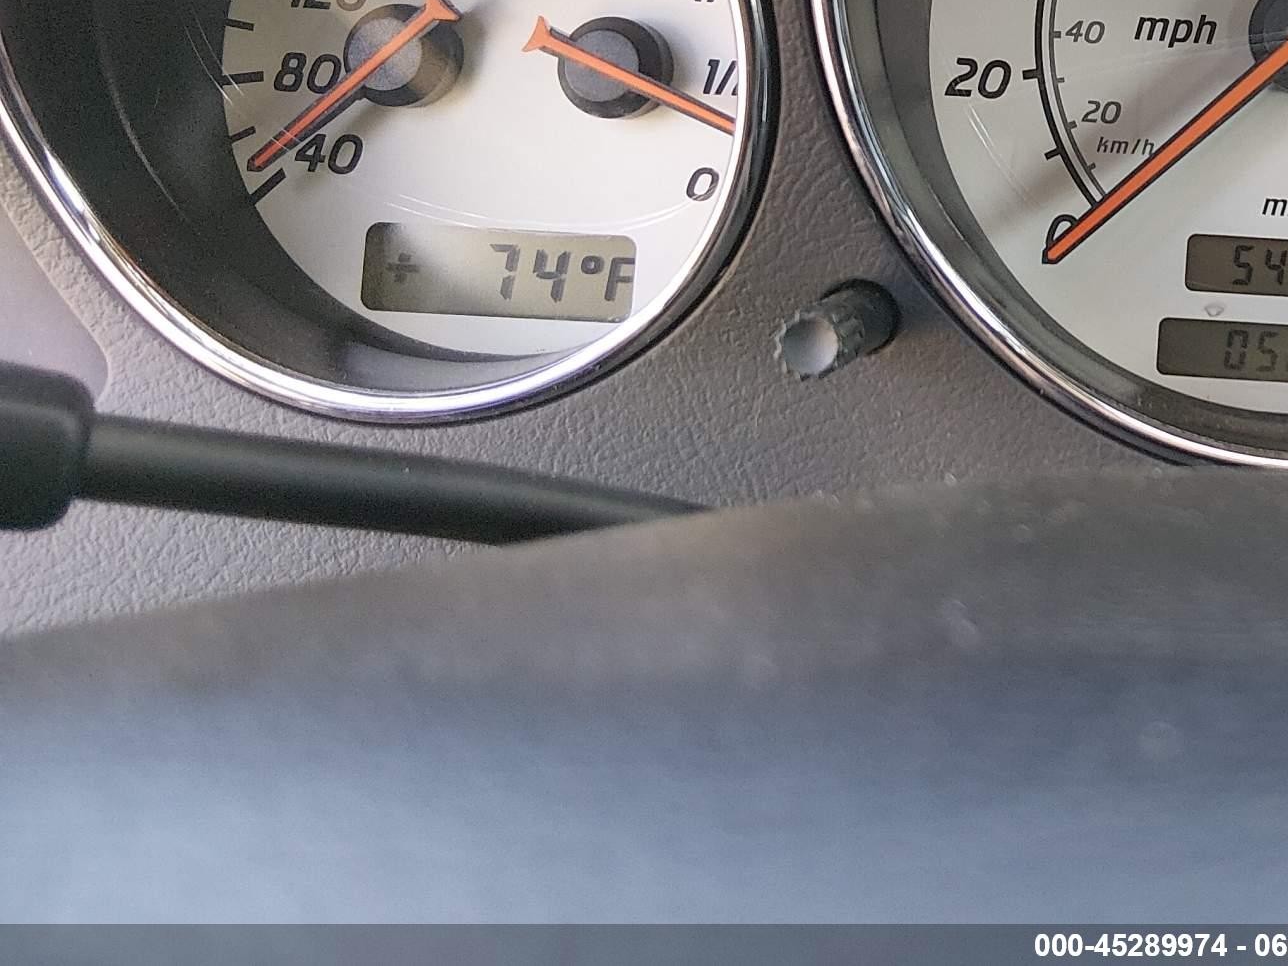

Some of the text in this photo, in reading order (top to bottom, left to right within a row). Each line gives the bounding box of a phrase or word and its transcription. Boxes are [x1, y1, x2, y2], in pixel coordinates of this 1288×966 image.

[1065, 21, 1106, 44] 40
[1134, 14, 1217, 48] mph
[273, 52, 342, 94] 80
[945, 57, 1012, 99] 20
[1081, 100, 1122, 124] 20
[294, 133, 364, 175] 40
[1096, 136, 1155, 155] km/h
[686, 167, 720, 201] 0
